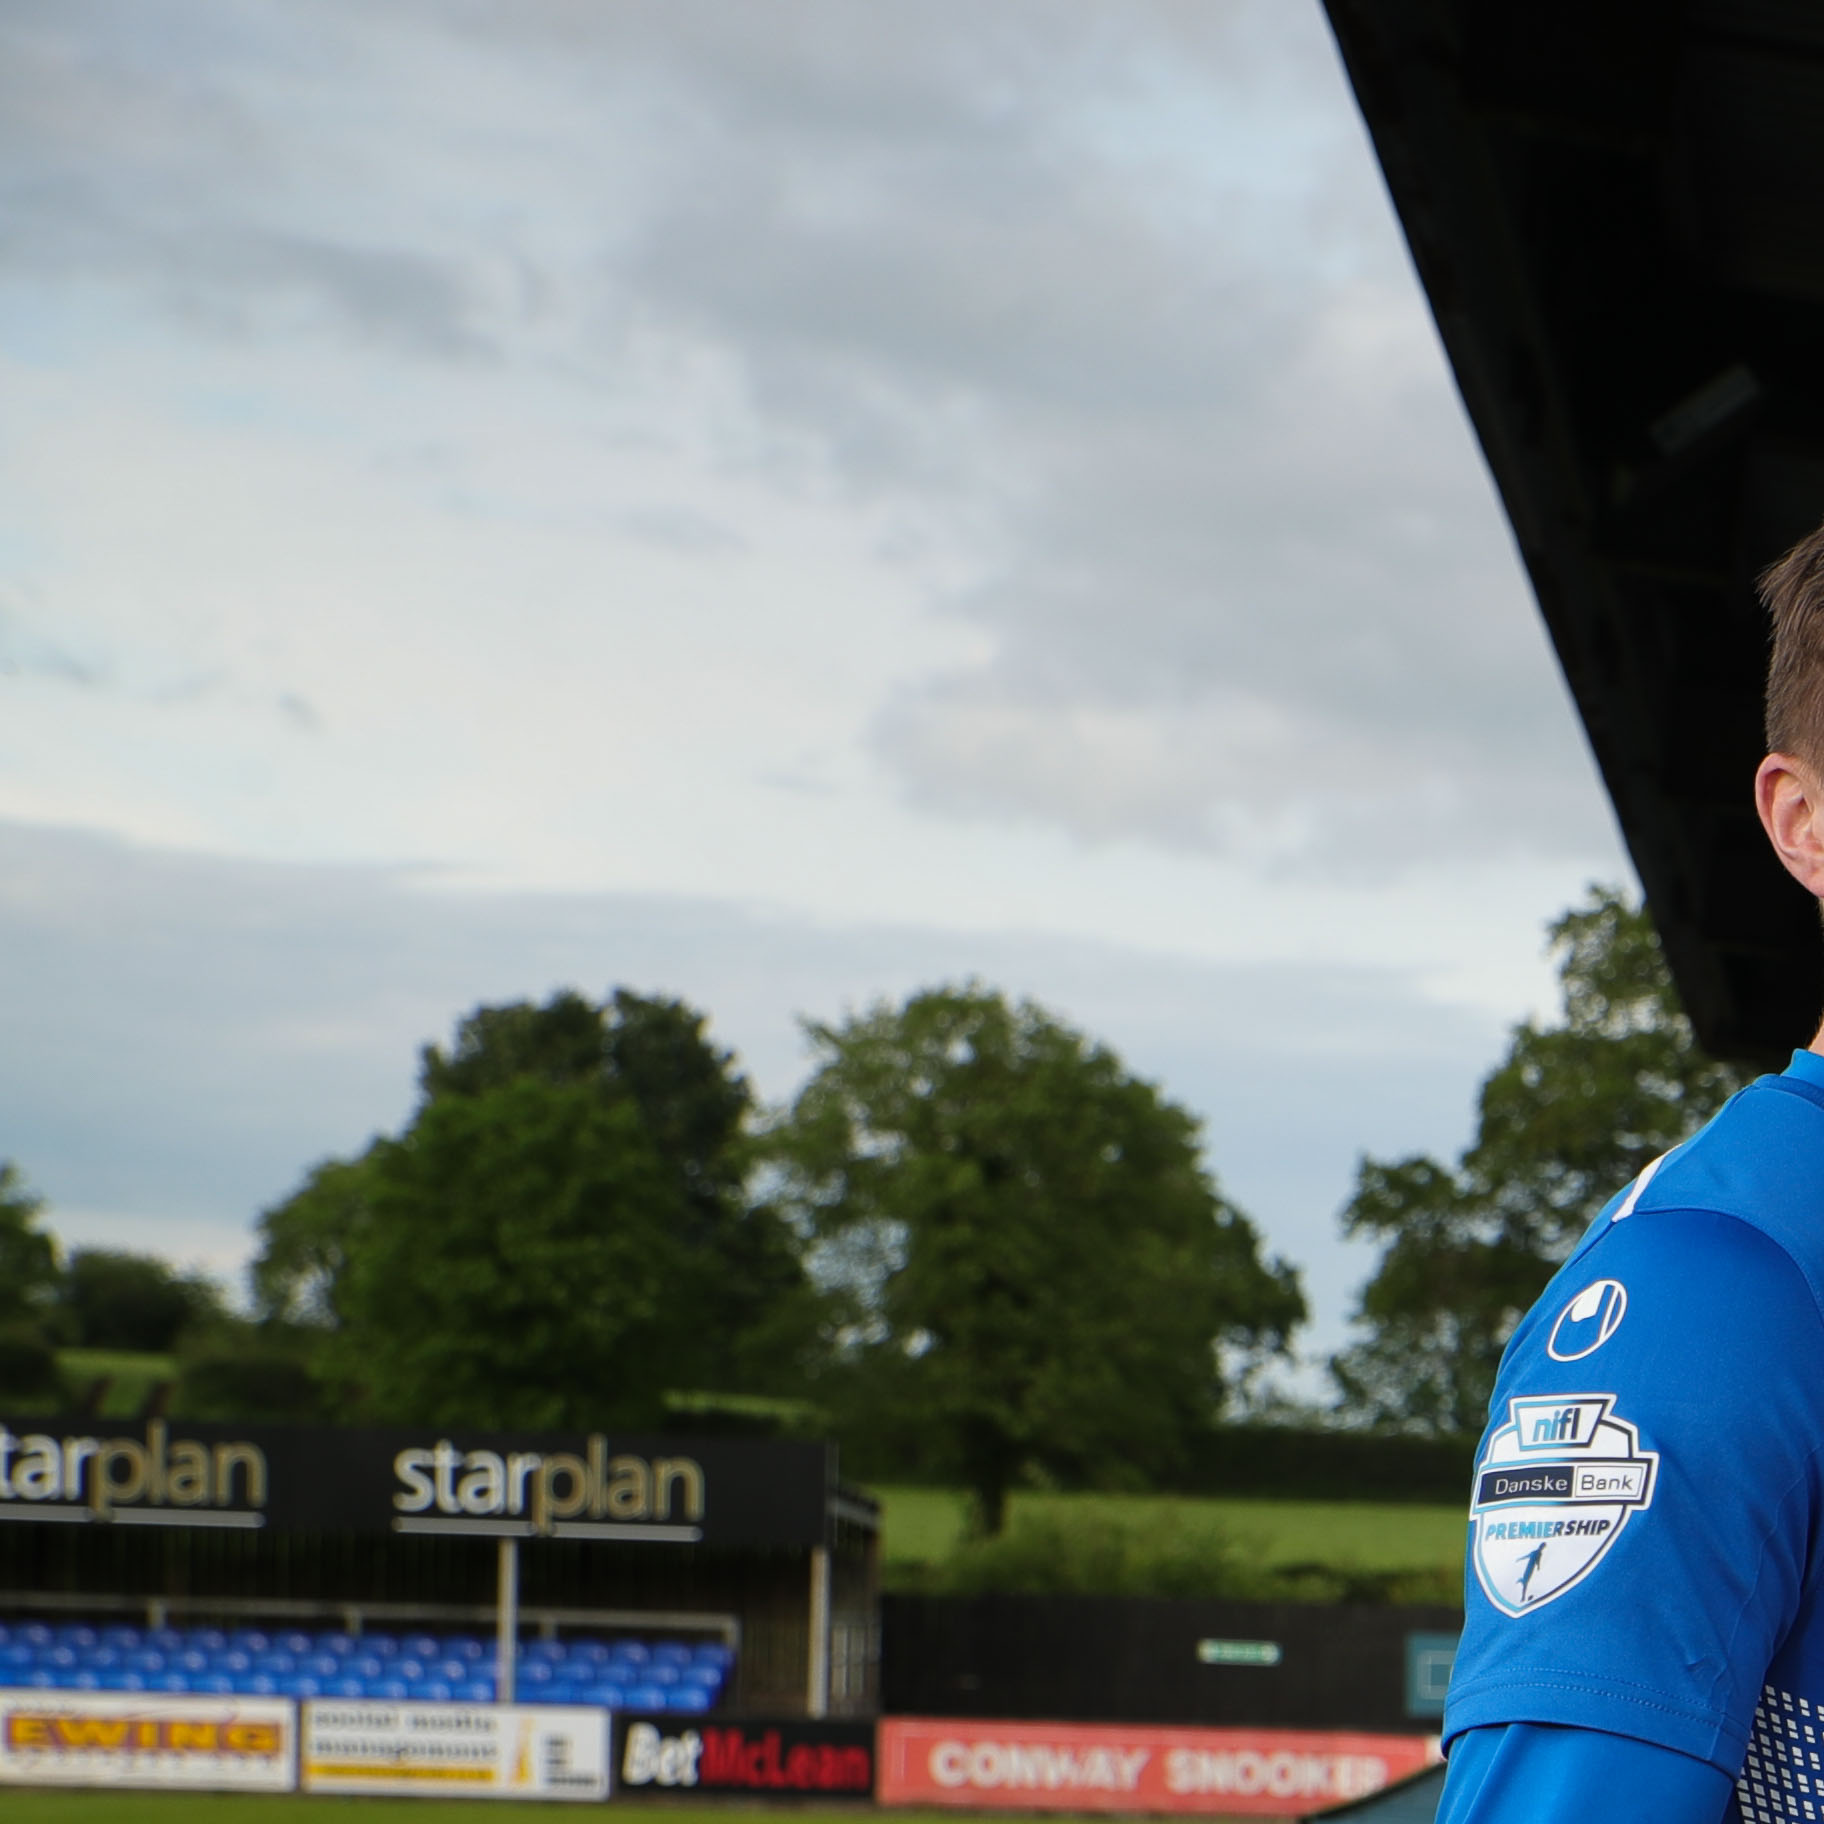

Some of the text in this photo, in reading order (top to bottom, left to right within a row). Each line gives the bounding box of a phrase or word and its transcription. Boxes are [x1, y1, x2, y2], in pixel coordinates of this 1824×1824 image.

[1532, 1407, 1582, 1442] nifl
[0, 1418, 268, 1524] tarplan
[394, 1433, 705, 1534] starplan
[1494, 1473, 1634, 1495] Danske Bank
[1484, 1519, 1612, 1541] PREMIERSHIP
[7, 1715, 281, 1754] EWING
[928, 1740, 1389, 1799] CONWAY SNOOKER
